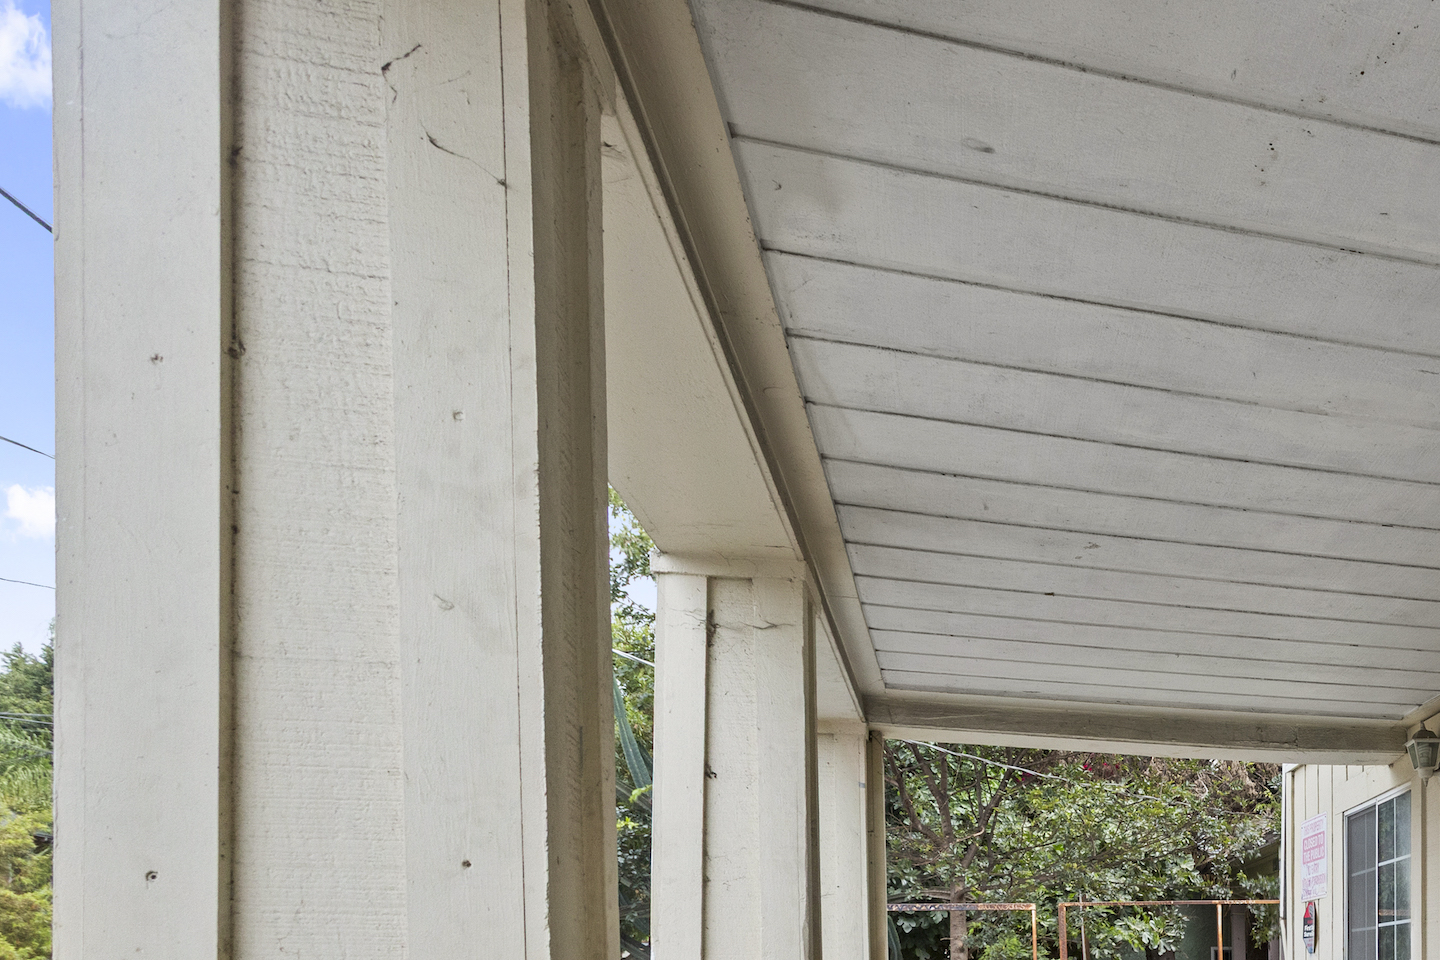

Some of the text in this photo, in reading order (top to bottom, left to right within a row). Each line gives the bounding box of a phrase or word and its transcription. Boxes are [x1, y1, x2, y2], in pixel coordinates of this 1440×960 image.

[1304, 833, 1324, 850] CLOSED TO
[1311, 845, 1325, 861] PUBLIC
